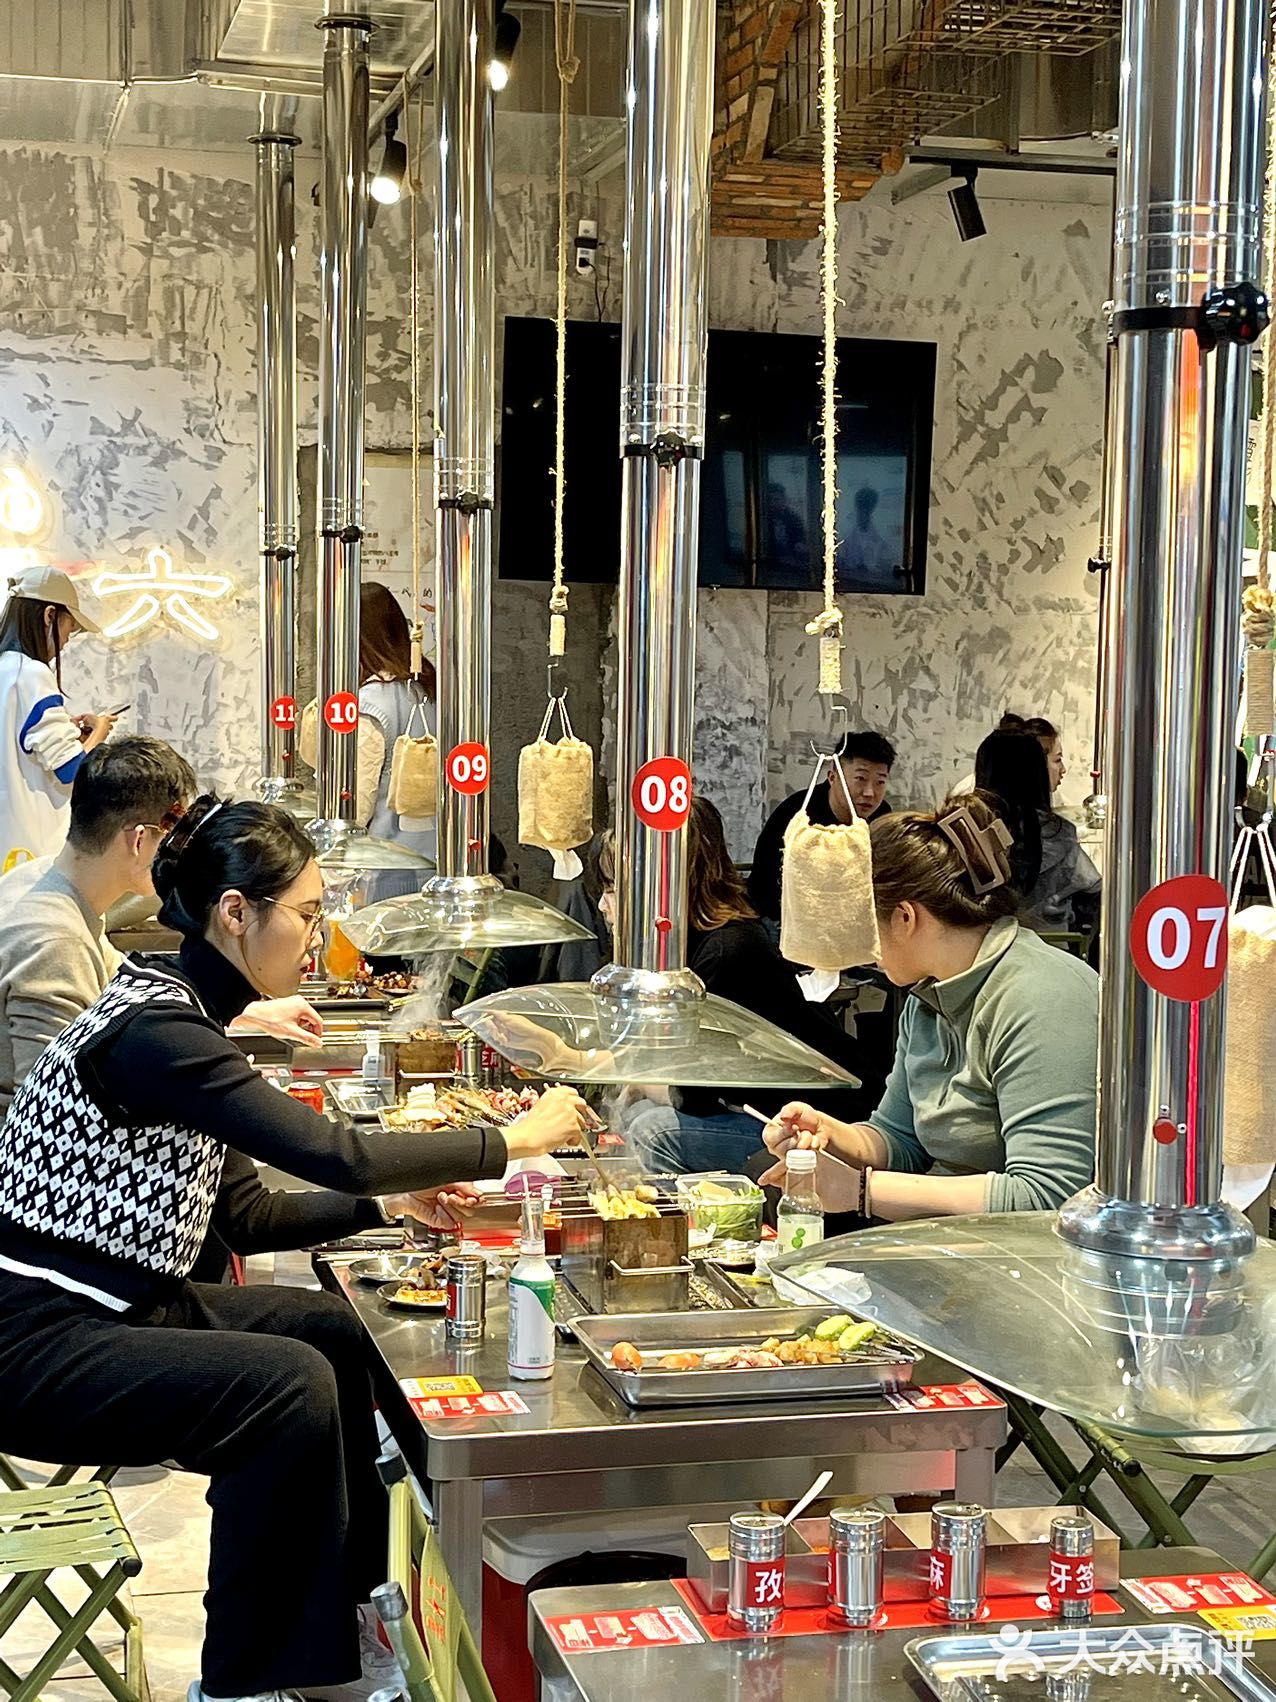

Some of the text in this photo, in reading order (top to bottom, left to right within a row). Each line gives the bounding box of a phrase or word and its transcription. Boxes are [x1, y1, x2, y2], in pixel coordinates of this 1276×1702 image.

[93, 549, 232, 640] 六
[275, 704, 295, 722] 11
[330, 702, 357, 723] 10
[452, 754, 487, 782] 09
[640, 775, 688, 813] 08
[1146, 906, 1226, 970] 07
[1049, 1560, 1095, 1594] 牙签
